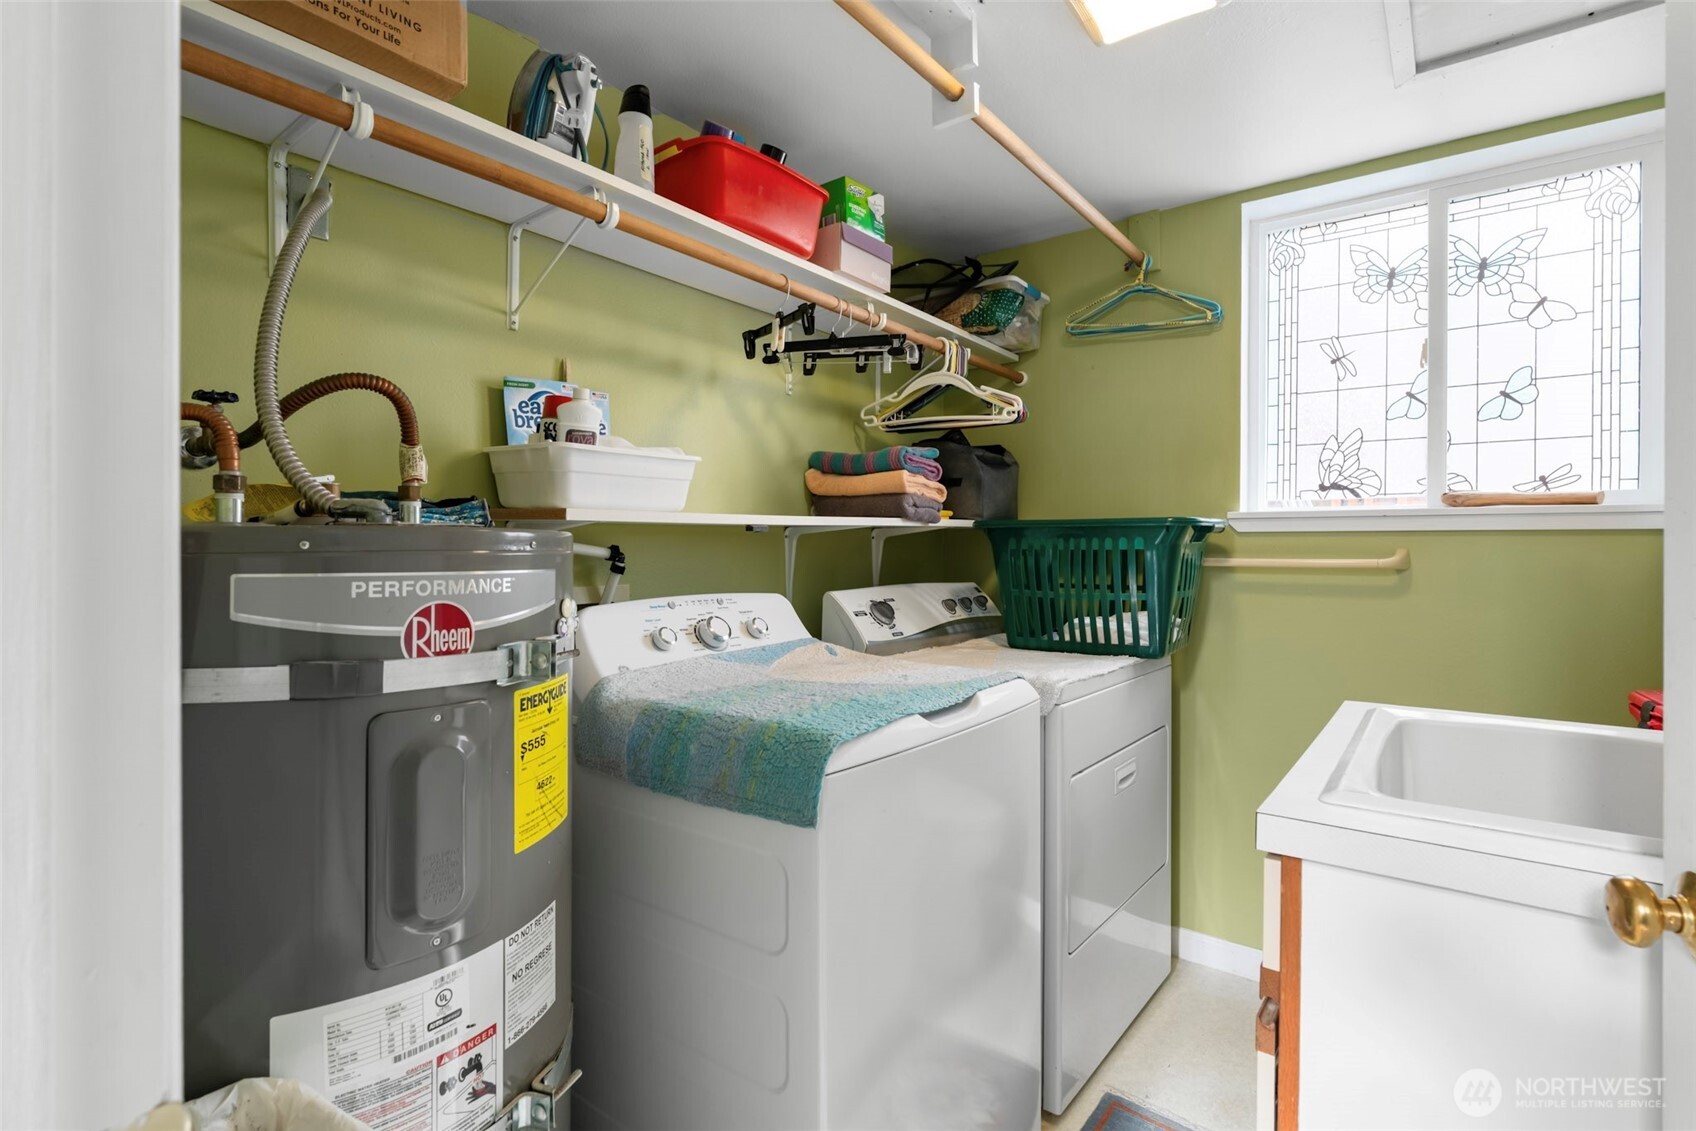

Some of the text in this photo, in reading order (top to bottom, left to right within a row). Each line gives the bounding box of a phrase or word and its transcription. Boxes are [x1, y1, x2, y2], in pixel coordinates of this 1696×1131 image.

[305, 0, 402, 46] ons For Your Life
[379, 4, 422, 33] LIVING
[518, 400, 545, 415] ea
[351, 577, 513, 598] PERFORMANCE
[412, 604, 471, 658] Rheem
[520, 734, 546, 756] $555
[509, 904, 554, 947] DO NOT RETURN
[512, 967, 523, 982] NO
[453, 1027, 494, 1056] DANGER
[406, 1060, 433, 1075] CAUTION
